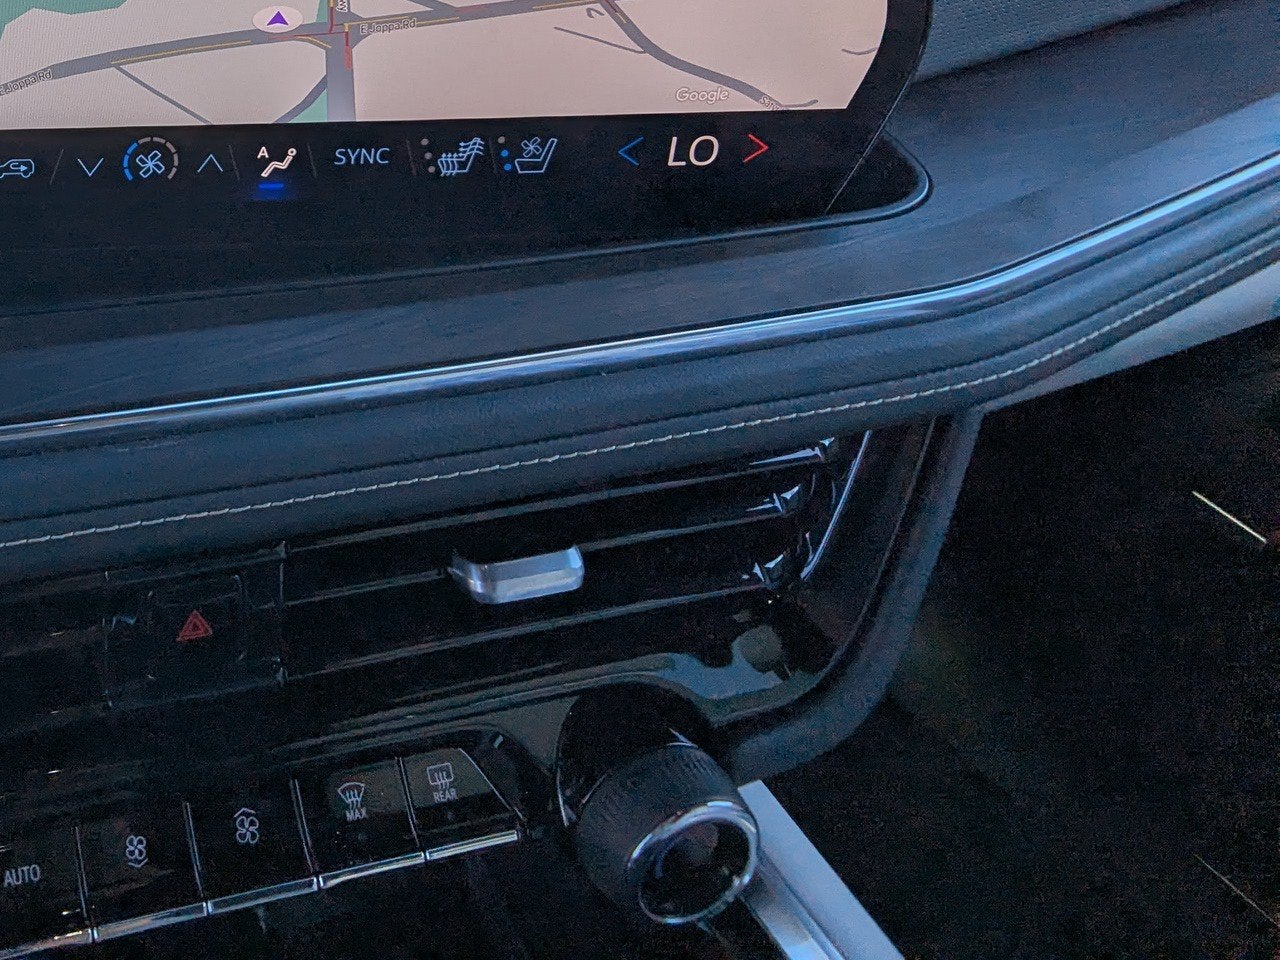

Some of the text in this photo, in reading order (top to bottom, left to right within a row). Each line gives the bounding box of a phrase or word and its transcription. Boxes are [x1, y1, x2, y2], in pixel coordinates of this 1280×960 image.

[361, 19, 417, 34] E Joppa Rd
[6, 74, 37, 93] Joppa
[37, 70, 52, 81] Rd
[676, 87, 729, 104] Google
[257, 147, 269, 159] A
[335, 147, 389, 165] SYNC
[667, 135, 719, 167] LO
[433, 788, 458, 803] REAR
[346, 807, 368, 822] MAX
[3, 864, 41, 888] AUTO
